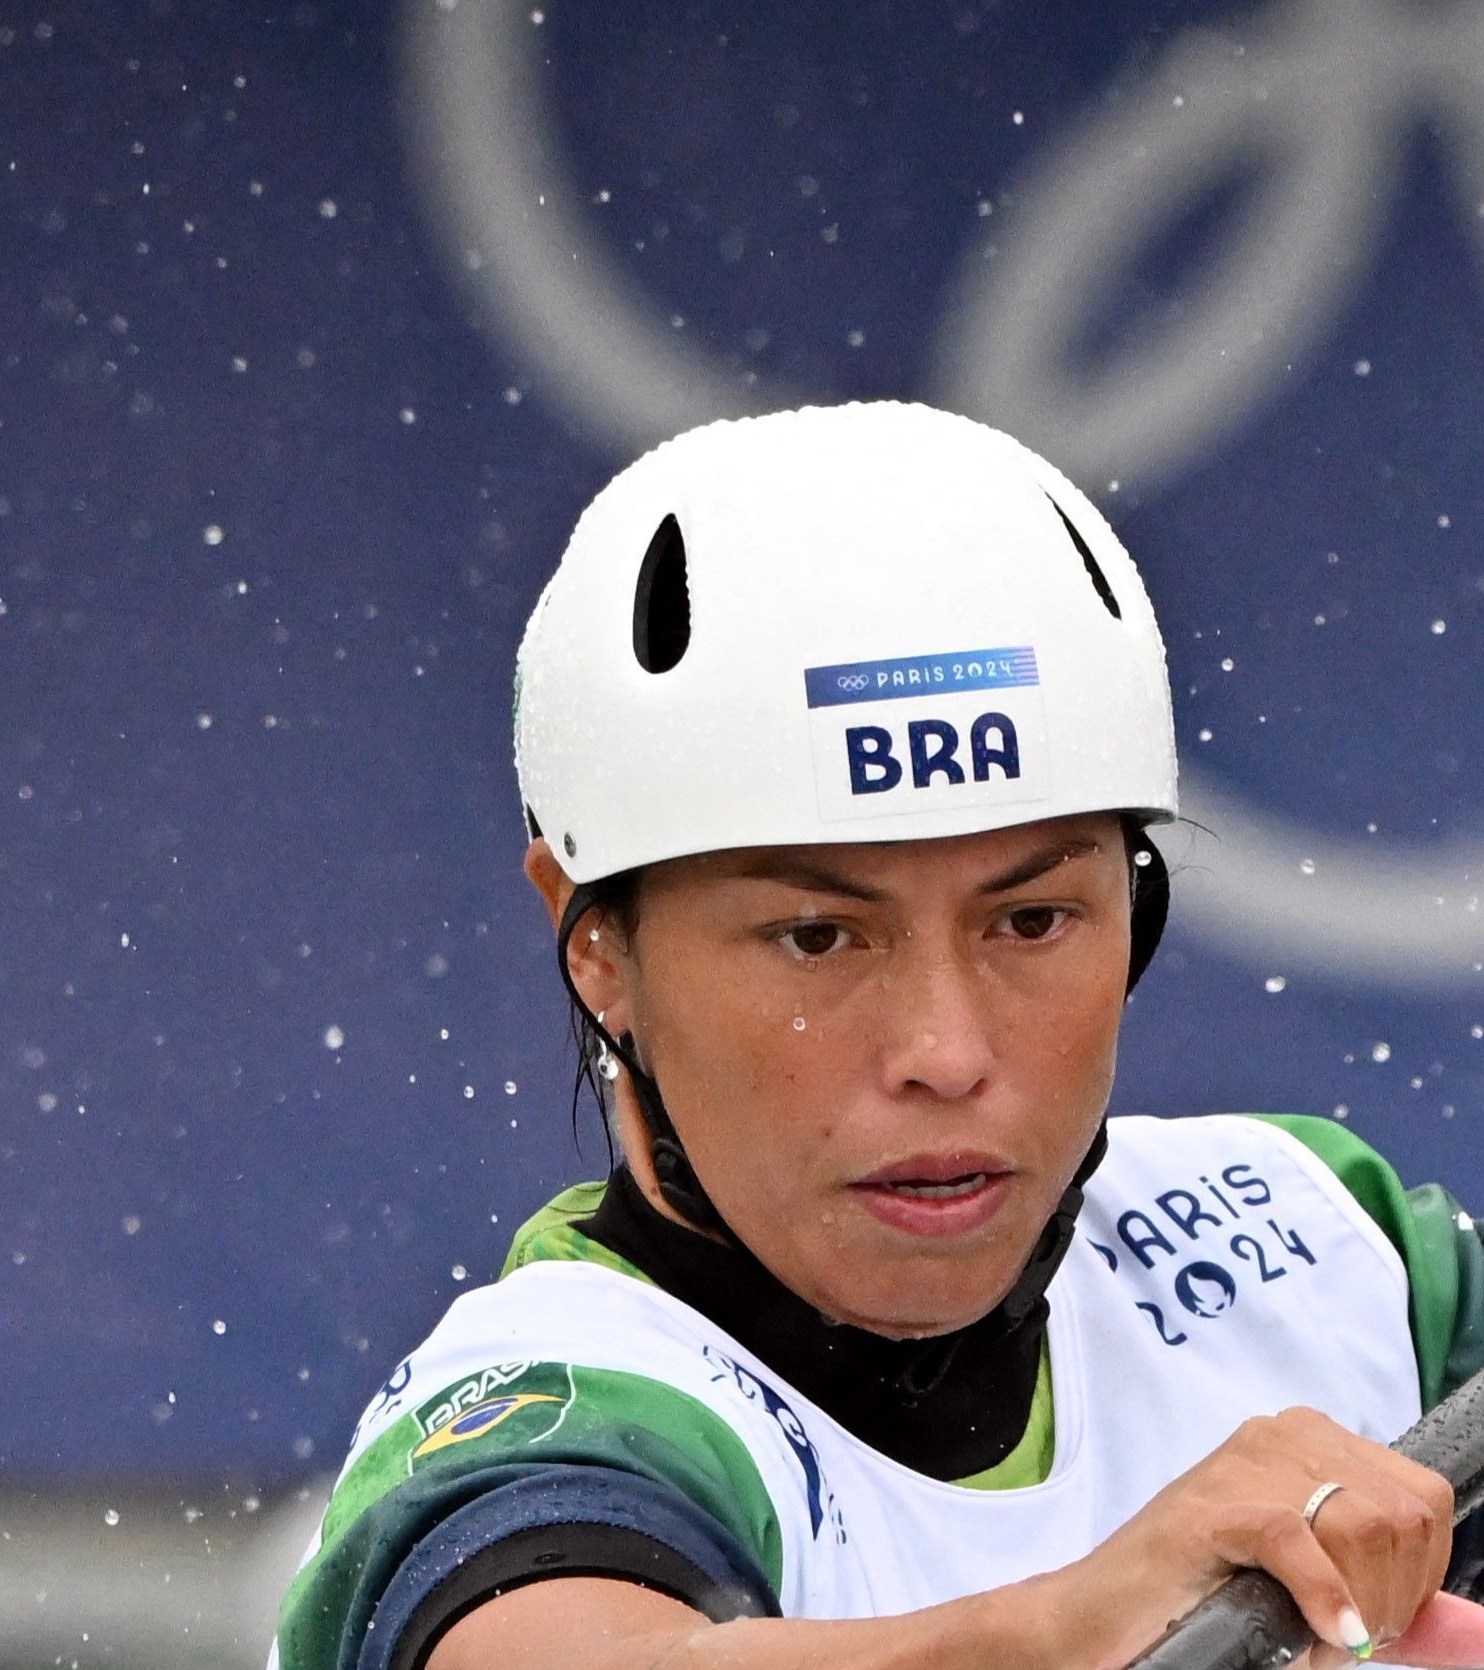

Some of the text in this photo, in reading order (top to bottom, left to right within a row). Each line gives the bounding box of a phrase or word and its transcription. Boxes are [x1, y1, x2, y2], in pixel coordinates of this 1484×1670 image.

[952, 660, 1013, 680] 2024
[845, 711, 1021, 795] BRA
[425, 1360, 541, 1435] BRAS
